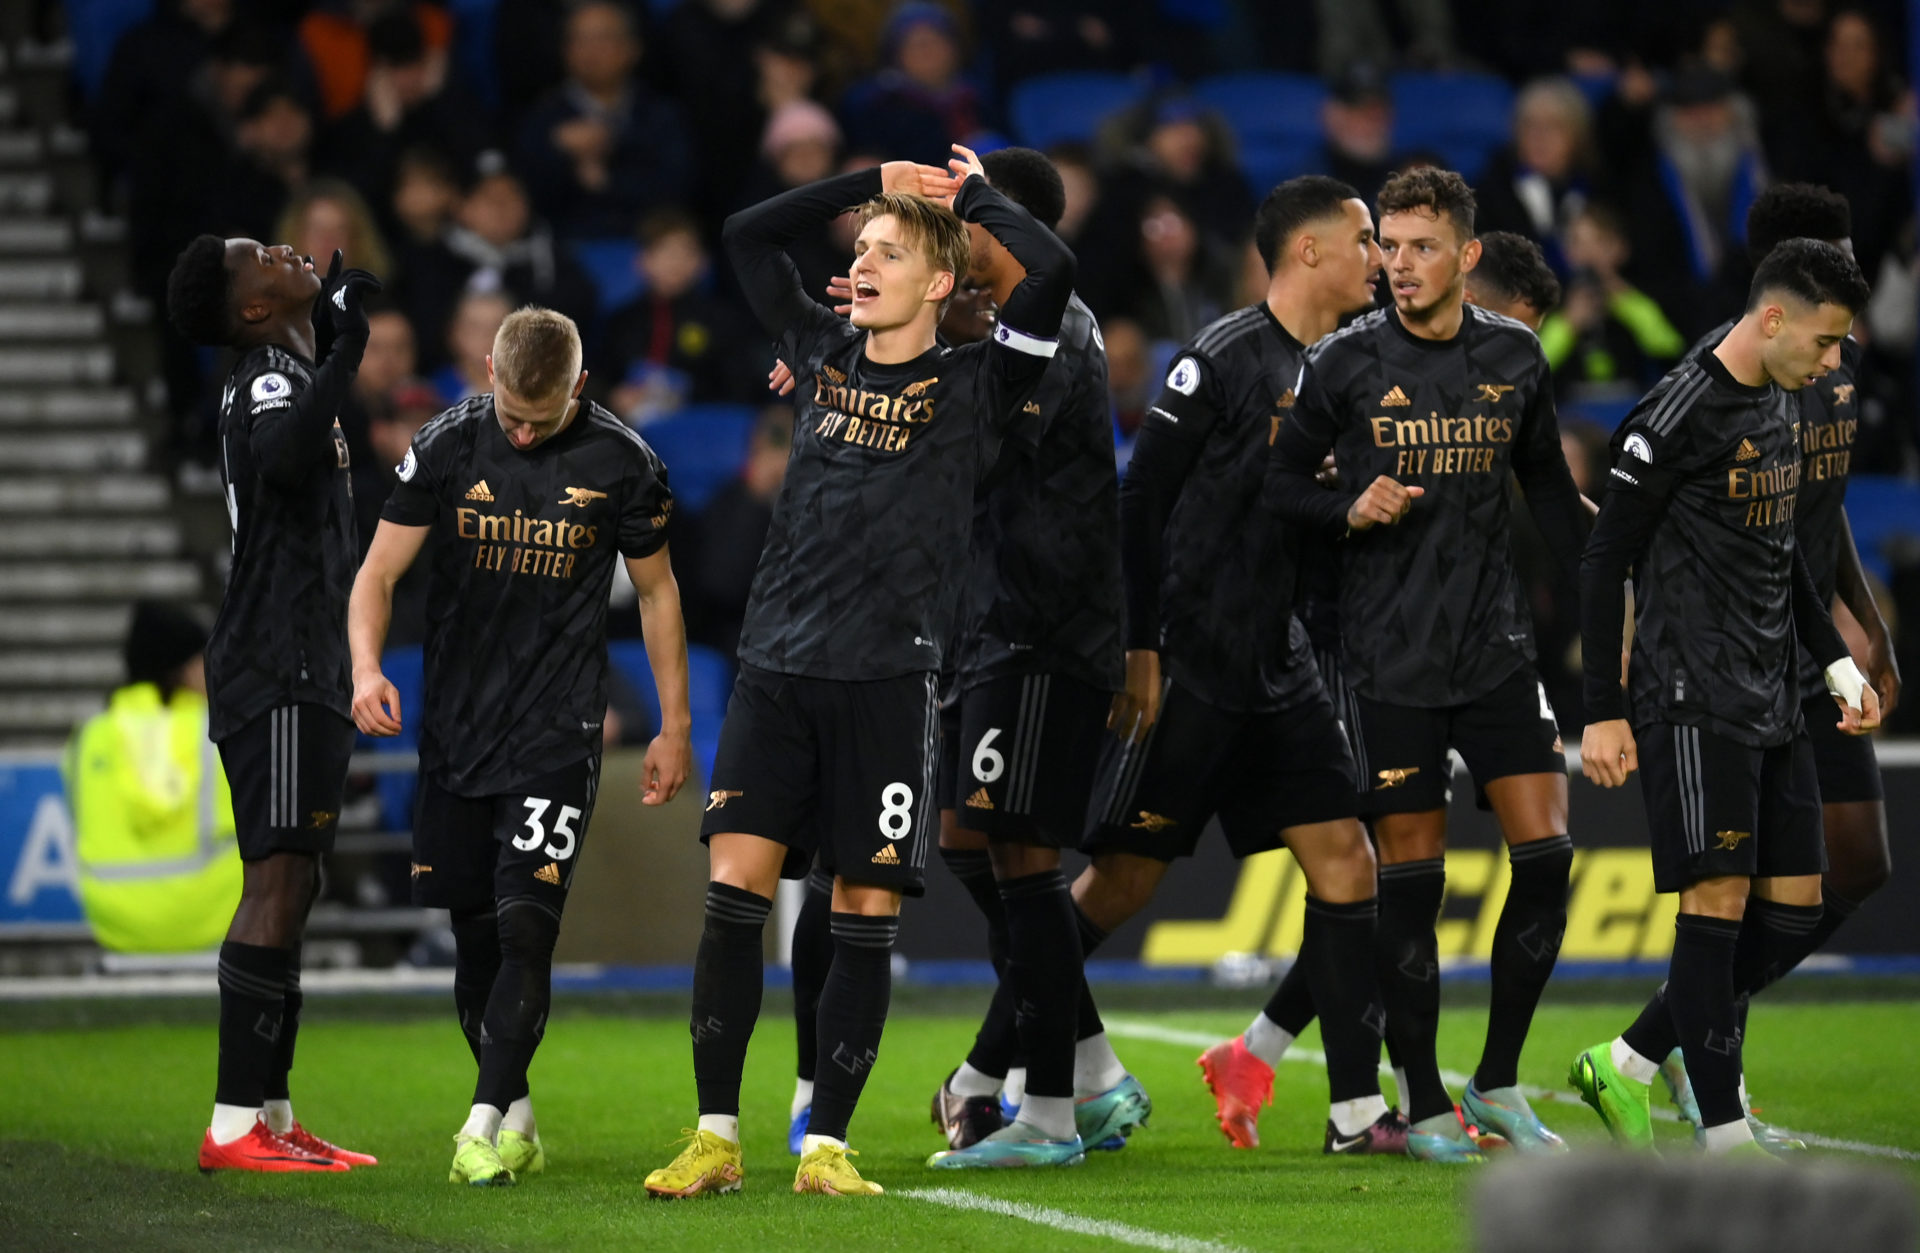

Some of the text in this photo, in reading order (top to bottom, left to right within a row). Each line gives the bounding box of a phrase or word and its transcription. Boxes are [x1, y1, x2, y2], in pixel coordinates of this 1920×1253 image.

[814, 373, 935, 423] Emirates
[843, 416, 910, 451] BETTER
[1370, 411, 1513, 448] Emirates
[1397, 448, 1494, 476] FLY BETTER
[456, 507, 598, 549] Emirates
[1745, 500, 1773, 527] FLY
[475, 545, 576, 578] FLY BETTER
[972, 727, 1005, 783] 6
[512, 796, 582, 860] 35
[878, 782, 914, 840] 8
